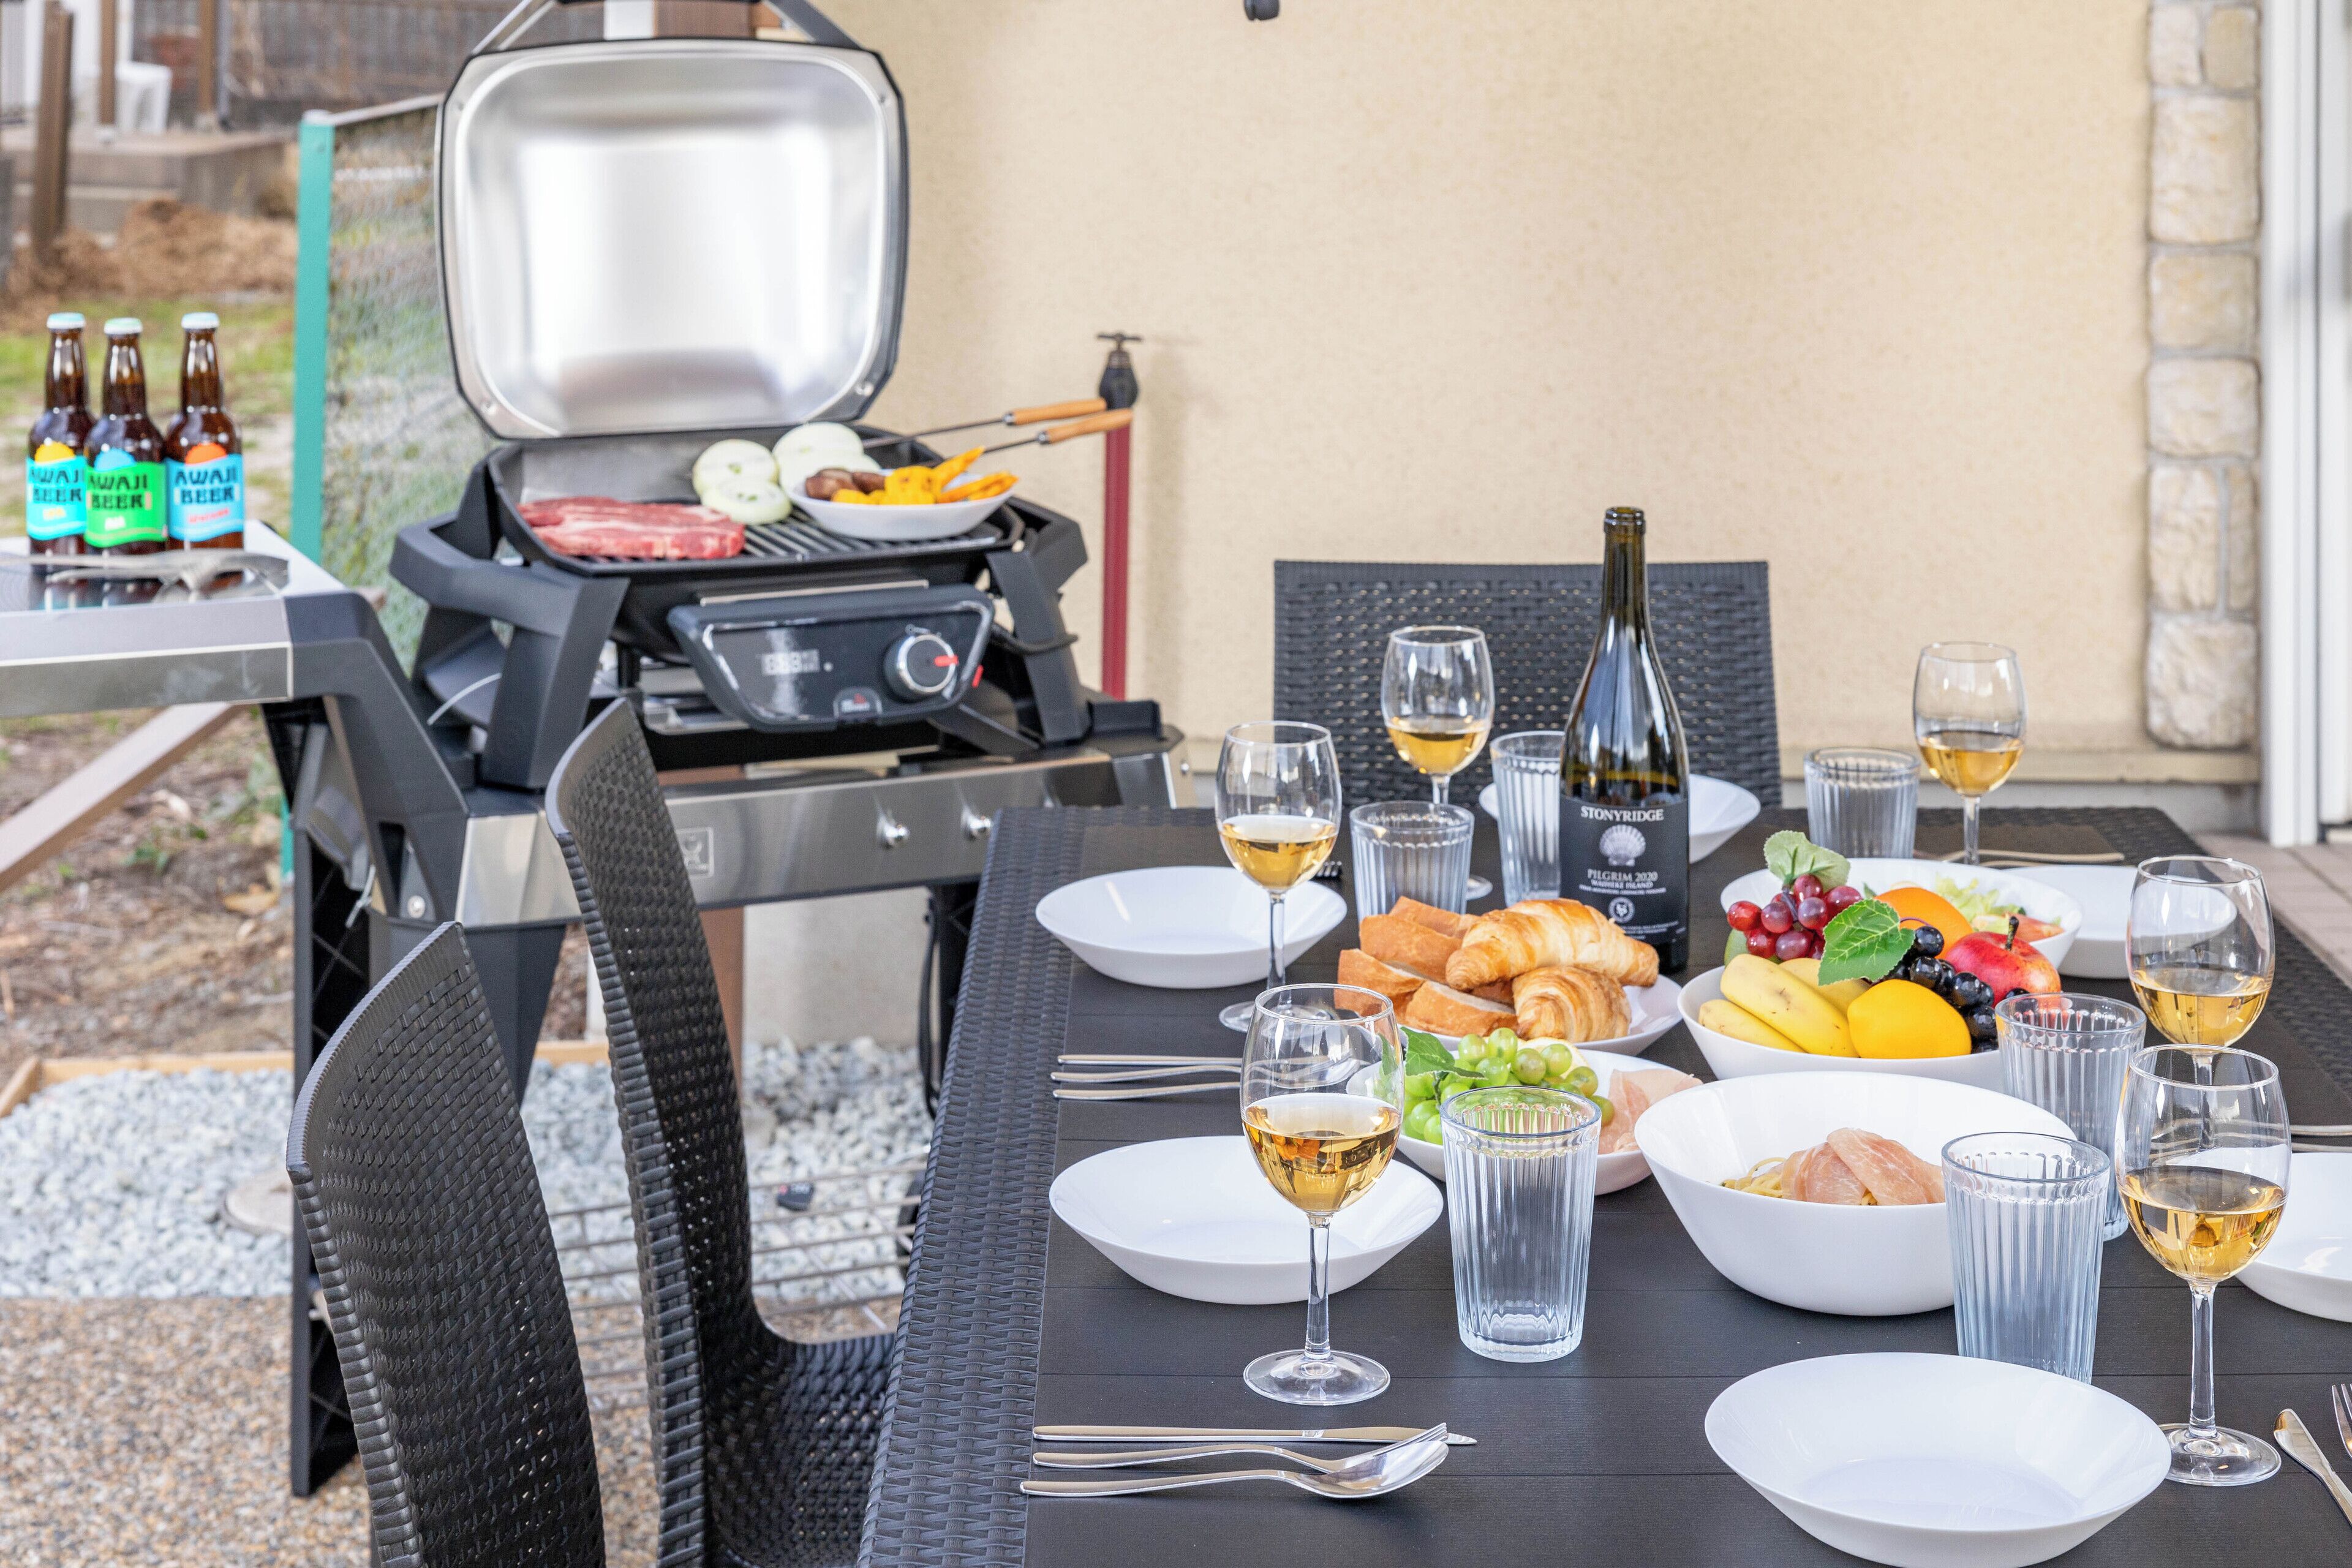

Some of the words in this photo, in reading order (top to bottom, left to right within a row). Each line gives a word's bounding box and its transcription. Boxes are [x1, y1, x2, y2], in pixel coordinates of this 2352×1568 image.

[175, 467, 237, 486] AWAJI
[34, 488, 82, 502] BEER
[92, 494, 143, 510] BEER
[181, 486, 233, 505] BEER
[1580, 805, 1665, 822] STONYRIDGE
[1588, 869, 1633, 881] PILGRIM
[1635, 871, 1659, 882] 2020
